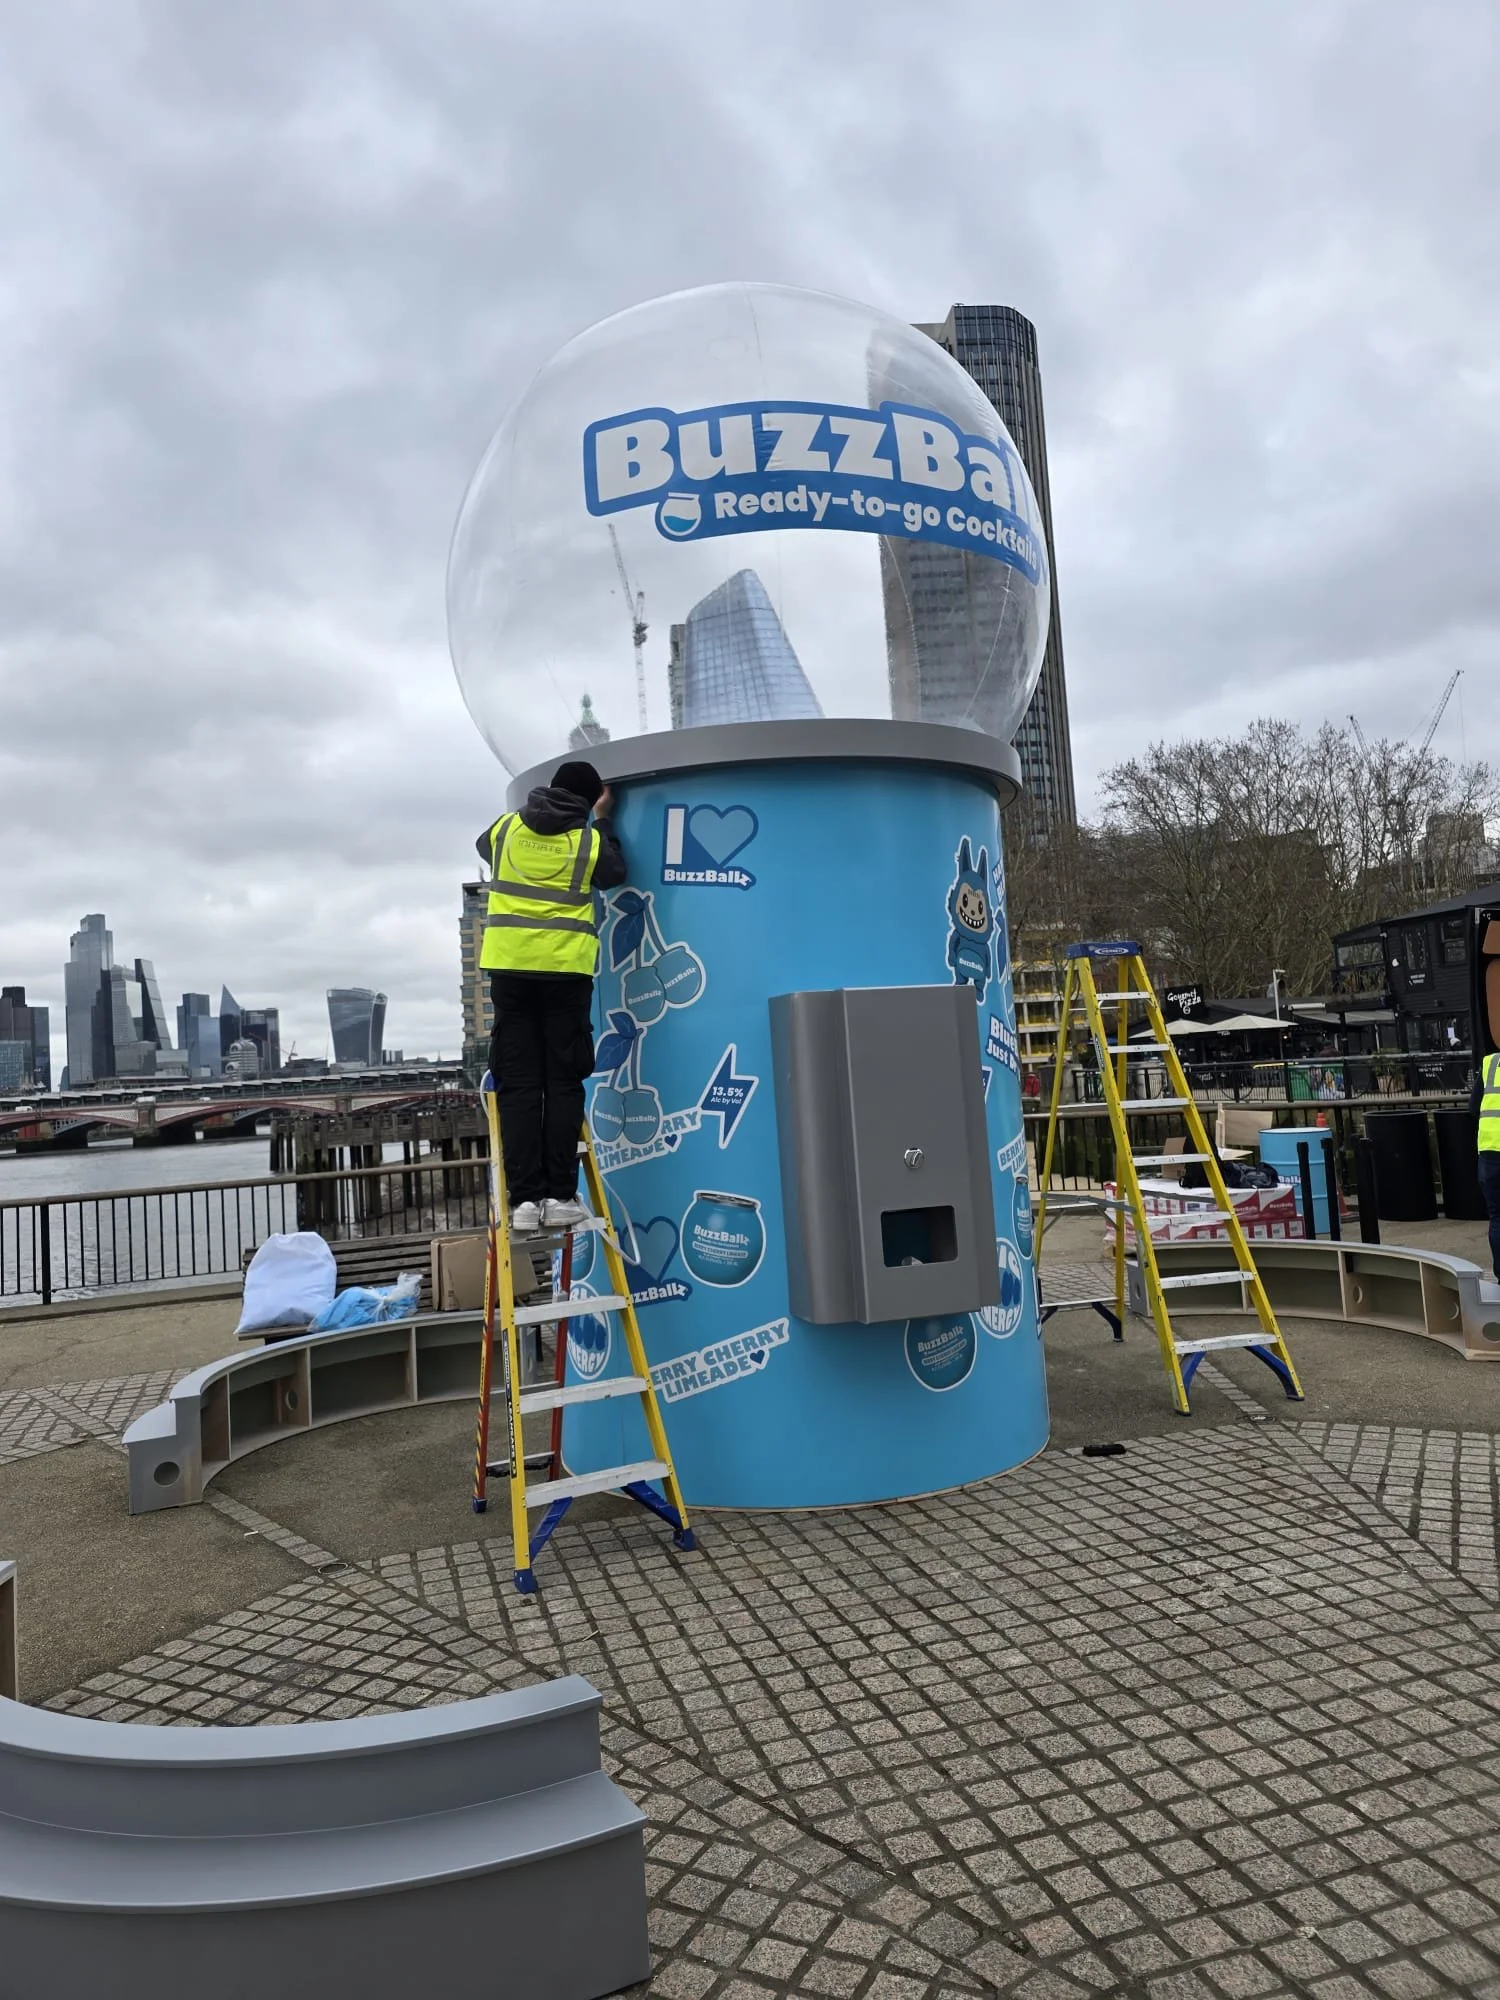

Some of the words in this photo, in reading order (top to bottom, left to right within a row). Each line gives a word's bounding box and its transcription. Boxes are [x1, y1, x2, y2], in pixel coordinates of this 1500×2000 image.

[715, 485, 942, 534] Ready-to-go
[664, 869, 752, 887] BuzzBallz
[712, 1086, 744, 1098] 13.5%
[722, 1097, 731, 1105] by
[693, 1224, 751, 1247] BuzzBallz
[632, 1281, 688, 1303] zzBallz
[651, 1355, 698, 1386] ERRY
[703, 1322, 786, 1366] CHERRY
[664, 1354, 752, 1399] LIMEADE
